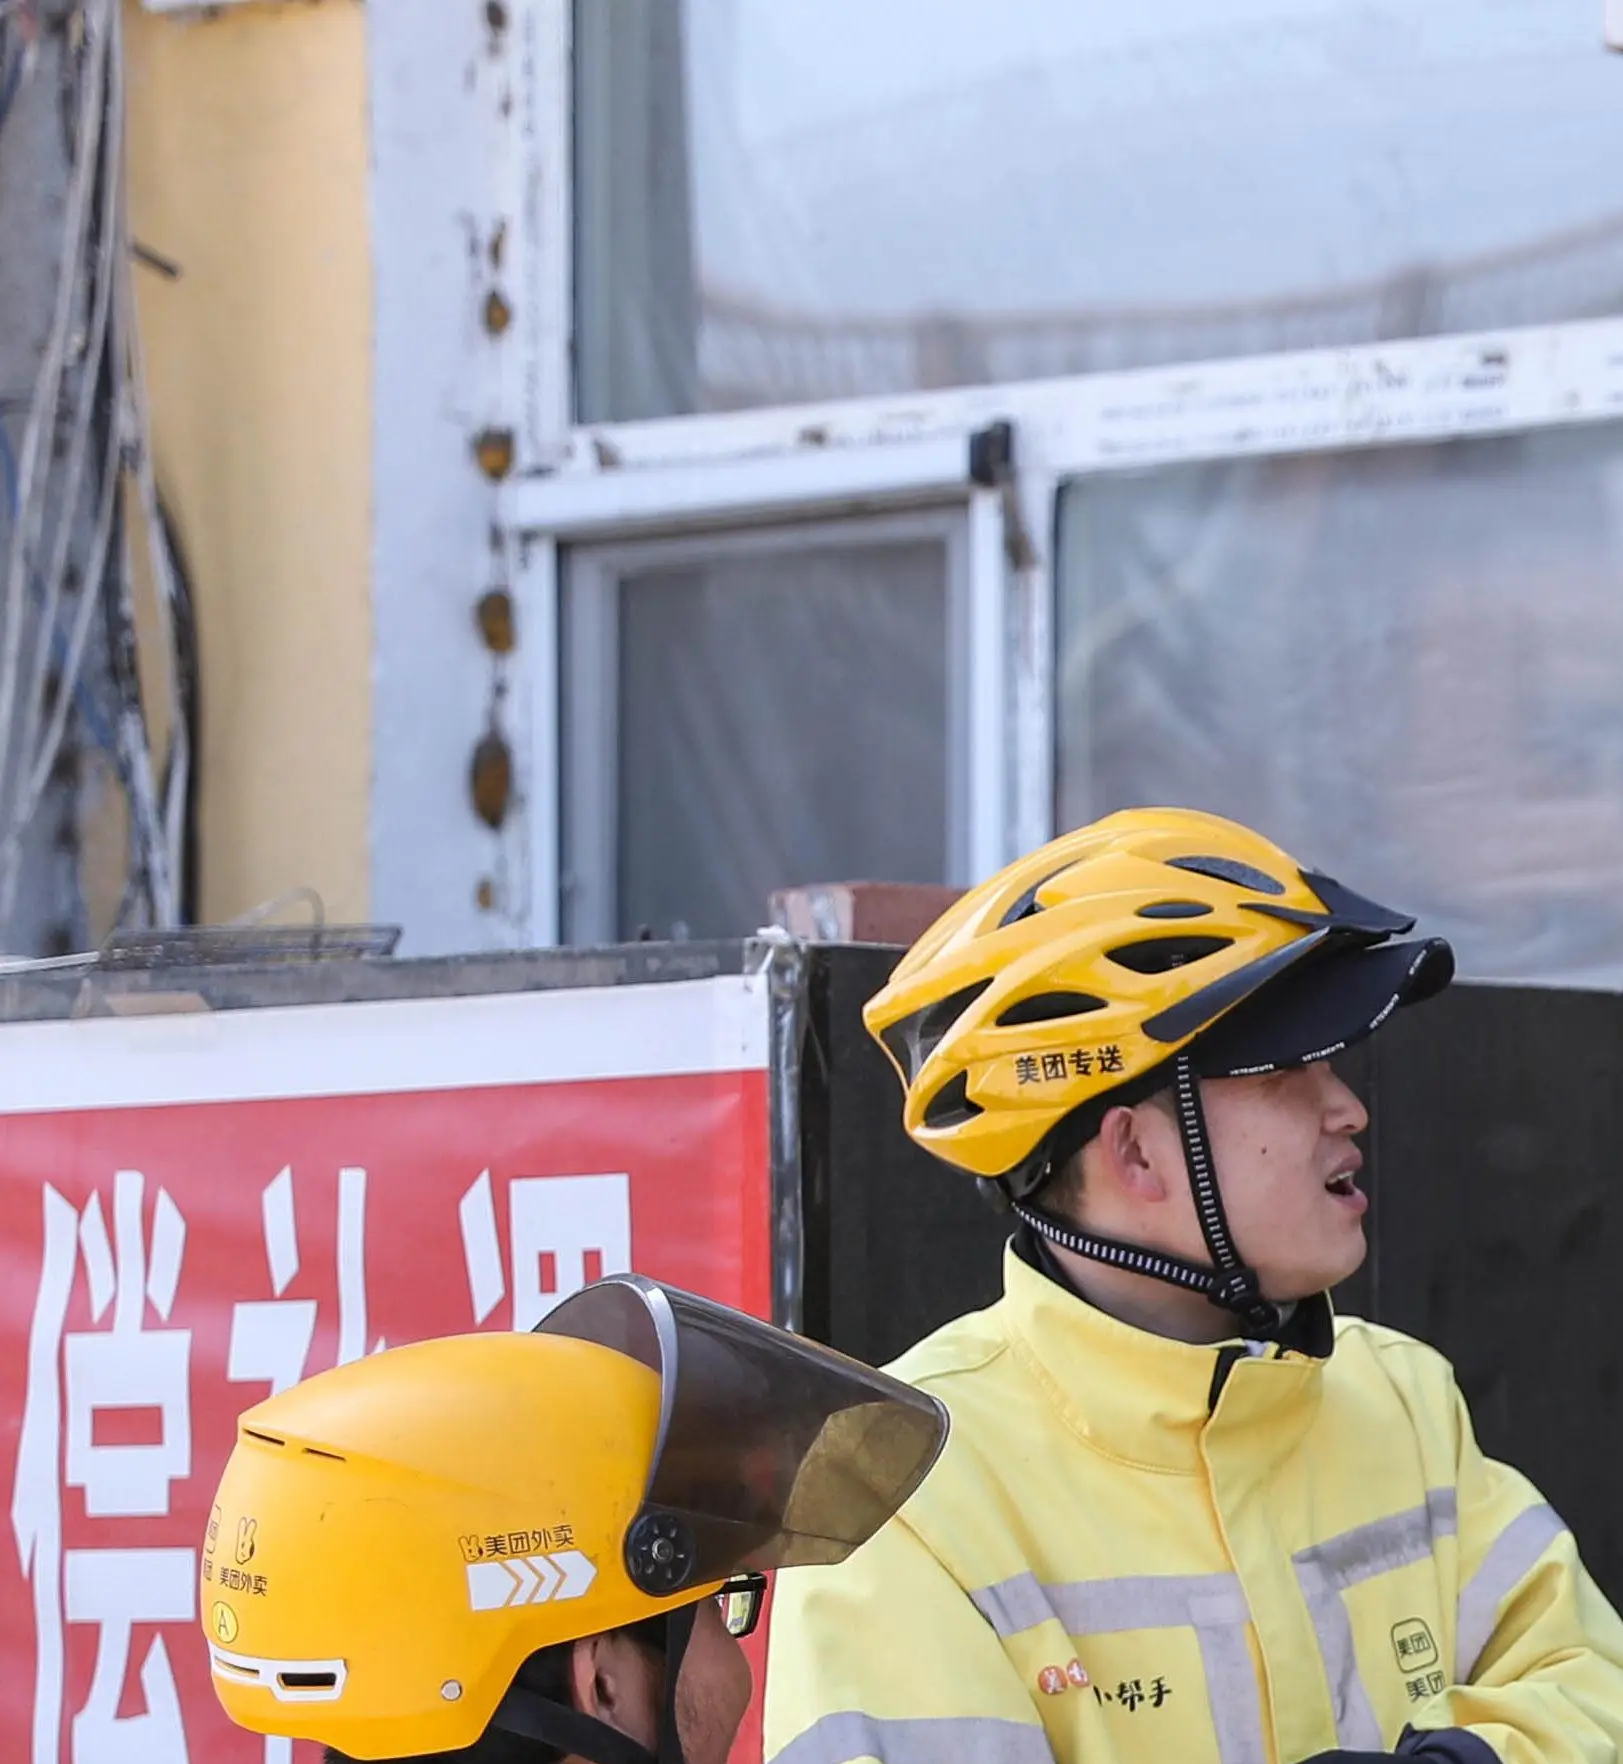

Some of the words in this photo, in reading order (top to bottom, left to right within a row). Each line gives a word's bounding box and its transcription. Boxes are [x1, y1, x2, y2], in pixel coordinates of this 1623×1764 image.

[1015, 1044, 1125, 1086] 美团专送
[485, 1524, 575, 1558] 美团外卖
[219, 1566, 268, 1597] 美团外卖
[1397, 1631, 1431, 1659] 美团
[1406, 1670, 1446, 1703] 美团
